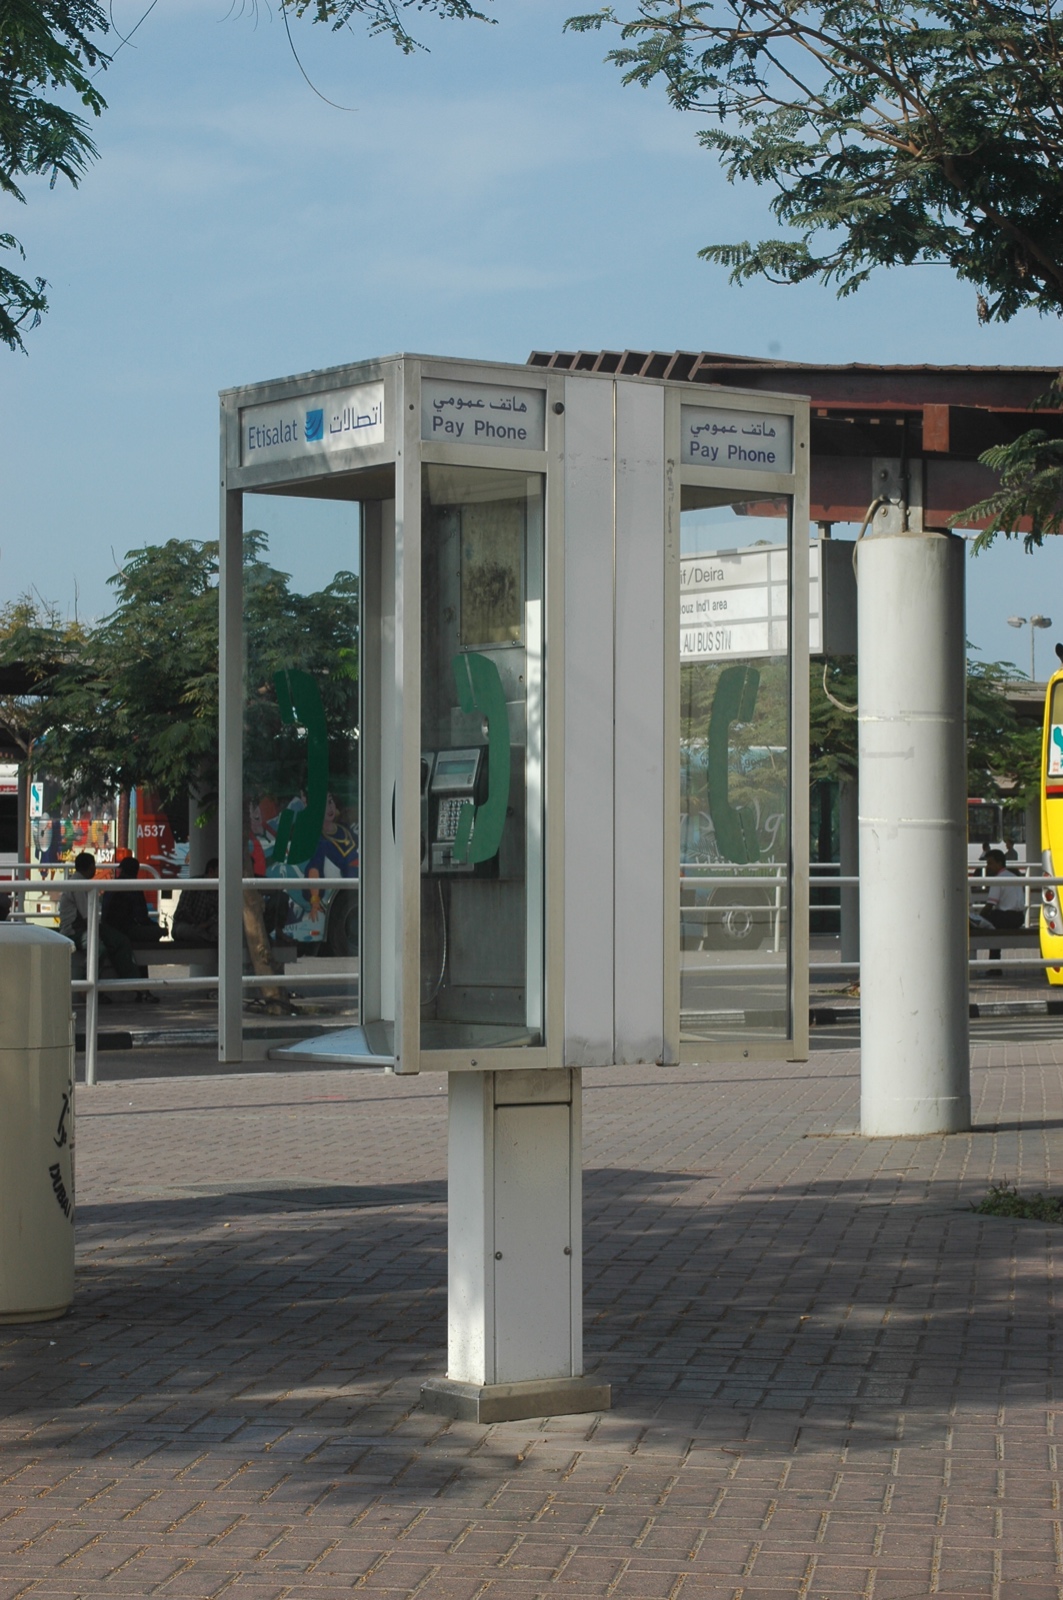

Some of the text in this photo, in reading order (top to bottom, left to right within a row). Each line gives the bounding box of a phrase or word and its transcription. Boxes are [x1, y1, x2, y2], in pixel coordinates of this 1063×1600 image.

[432, 396, 528, 413] هاتف عمومي
[329, 401, 383, 434] اتصالات
[248, 419, 298, 450] Etisalat
[432, 415, 528, 441] Pay Phone
[690, 421, 776, 438] هاتف عمومي
[690, 441, 776, 464] Pay Phone
[680, 567, 725, 586] if/Deira
[680, 604, 694, 615] ouz
[712, 600, 728, 611] area
[697, 631, 714, 652] BUS
[136, 824, 166, 838] A537
[97, 848, 115, 863] A537
[49, 1163, 71, 1218] DUBAI
